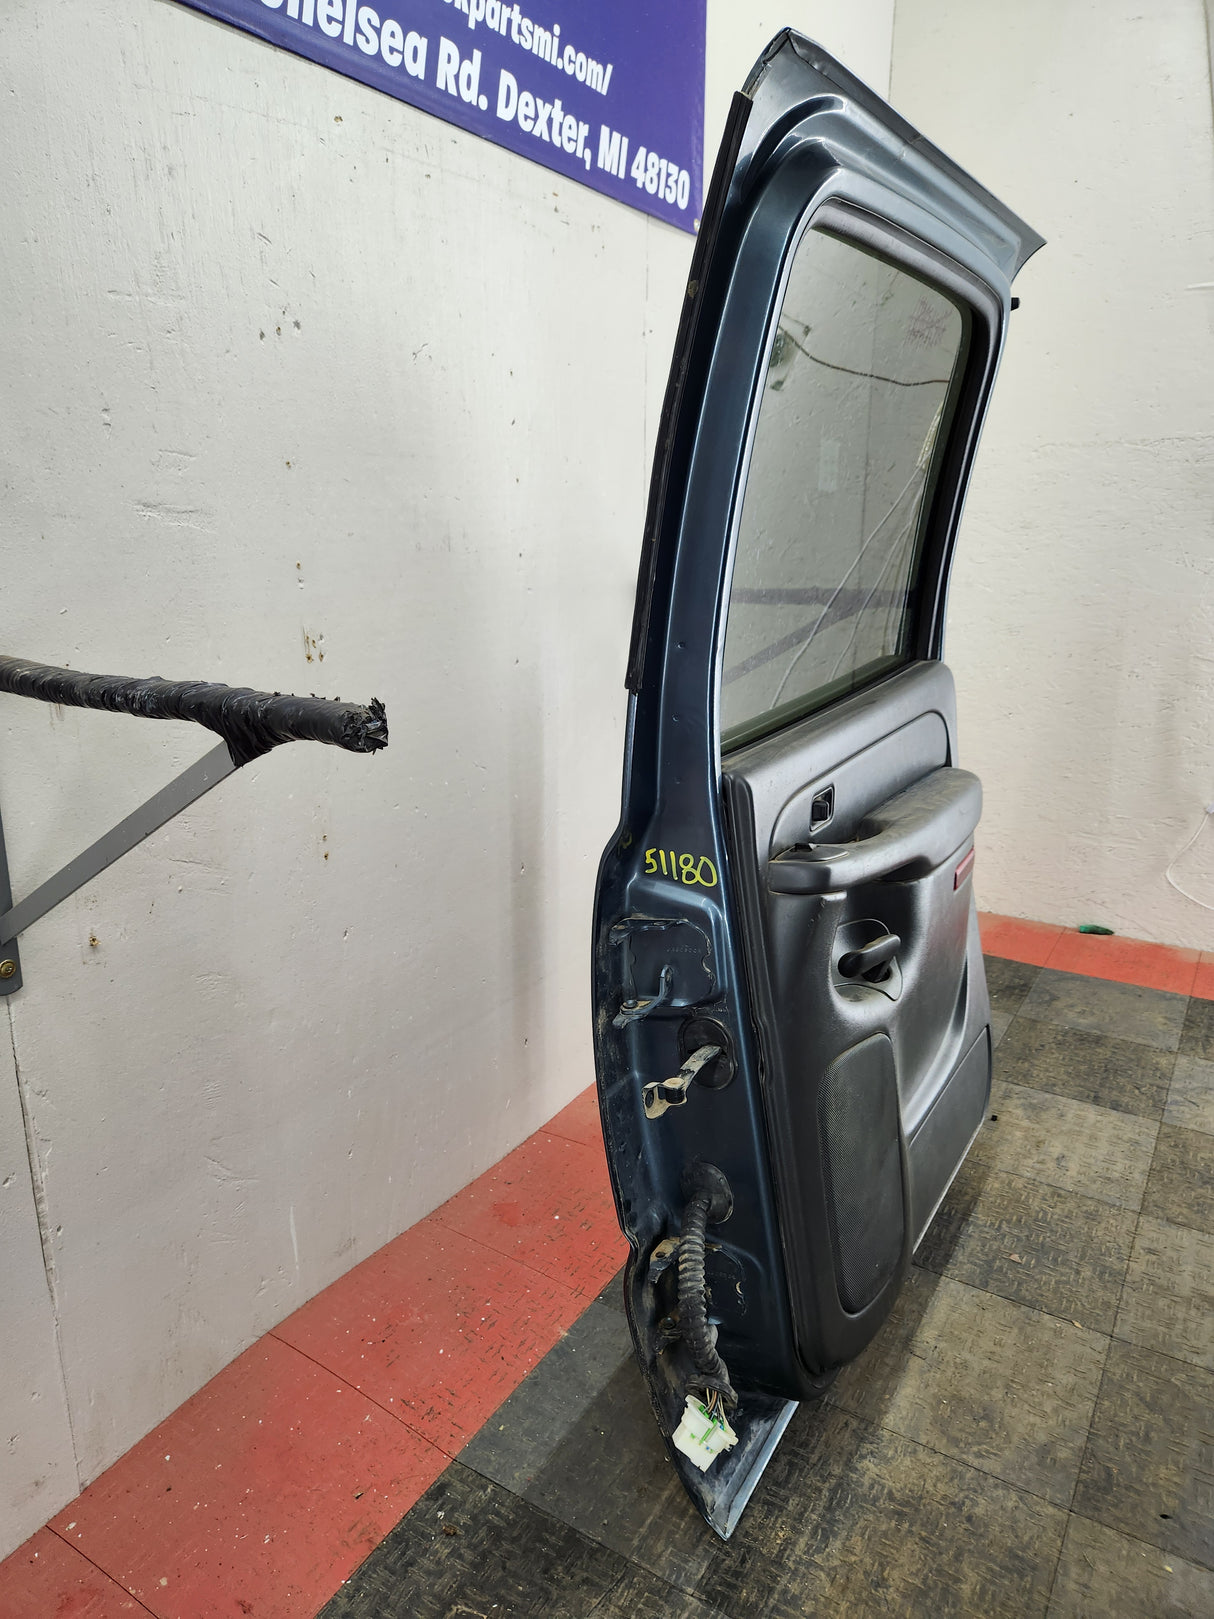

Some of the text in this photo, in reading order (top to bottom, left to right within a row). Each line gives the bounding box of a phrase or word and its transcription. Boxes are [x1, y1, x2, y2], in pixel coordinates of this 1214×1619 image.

[443, 0, 613, 96] partsmi.com/
[260, 0, 691, 210] elsea Rd. Dexter, MI 48130
[645, 848, 718, 887] 51180
